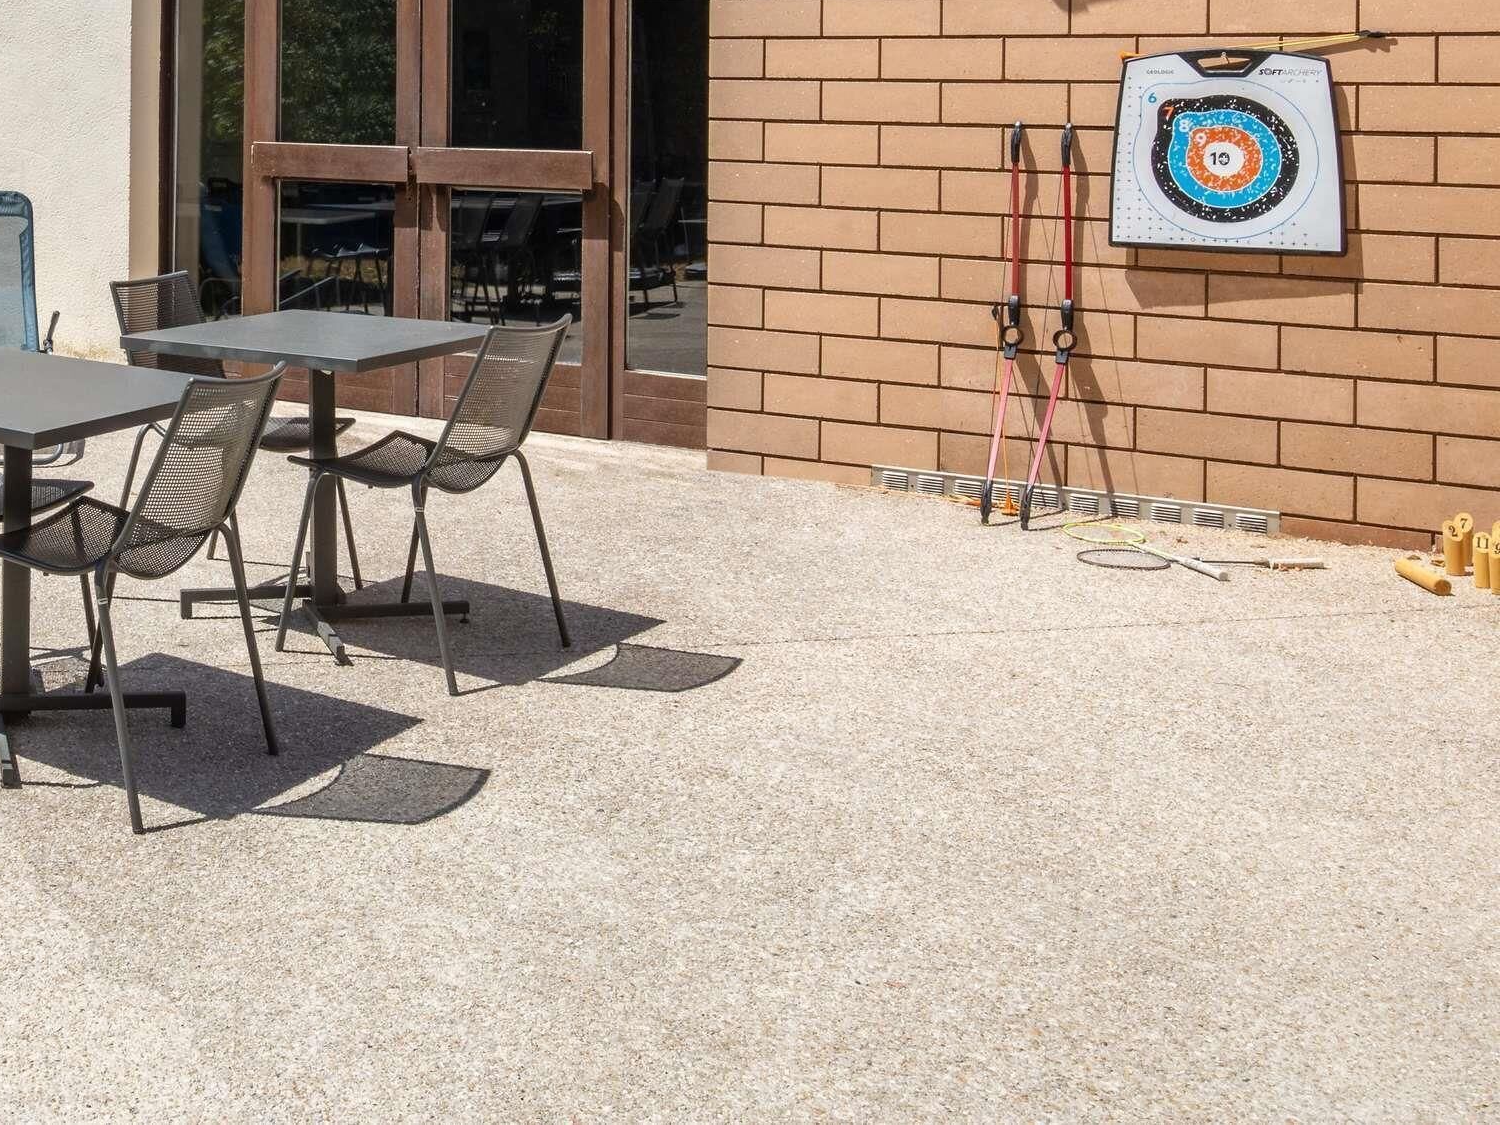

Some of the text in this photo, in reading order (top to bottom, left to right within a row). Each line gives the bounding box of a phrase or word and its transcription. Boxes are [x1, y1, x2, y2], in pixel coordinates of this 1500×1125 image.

[1148, 92, 1157, 103] 6
[1163, 106, 1174, 121] 7
[1179, 119, 1189, 132] 8
[1196, 133, 1206, 146] 9
[1210, 151, 1230, 166] 10
[1460, 518, 1468, 529] 7
[1448, 525, 1457, 537] 2
[1476, 537, 1489, 549] 11
